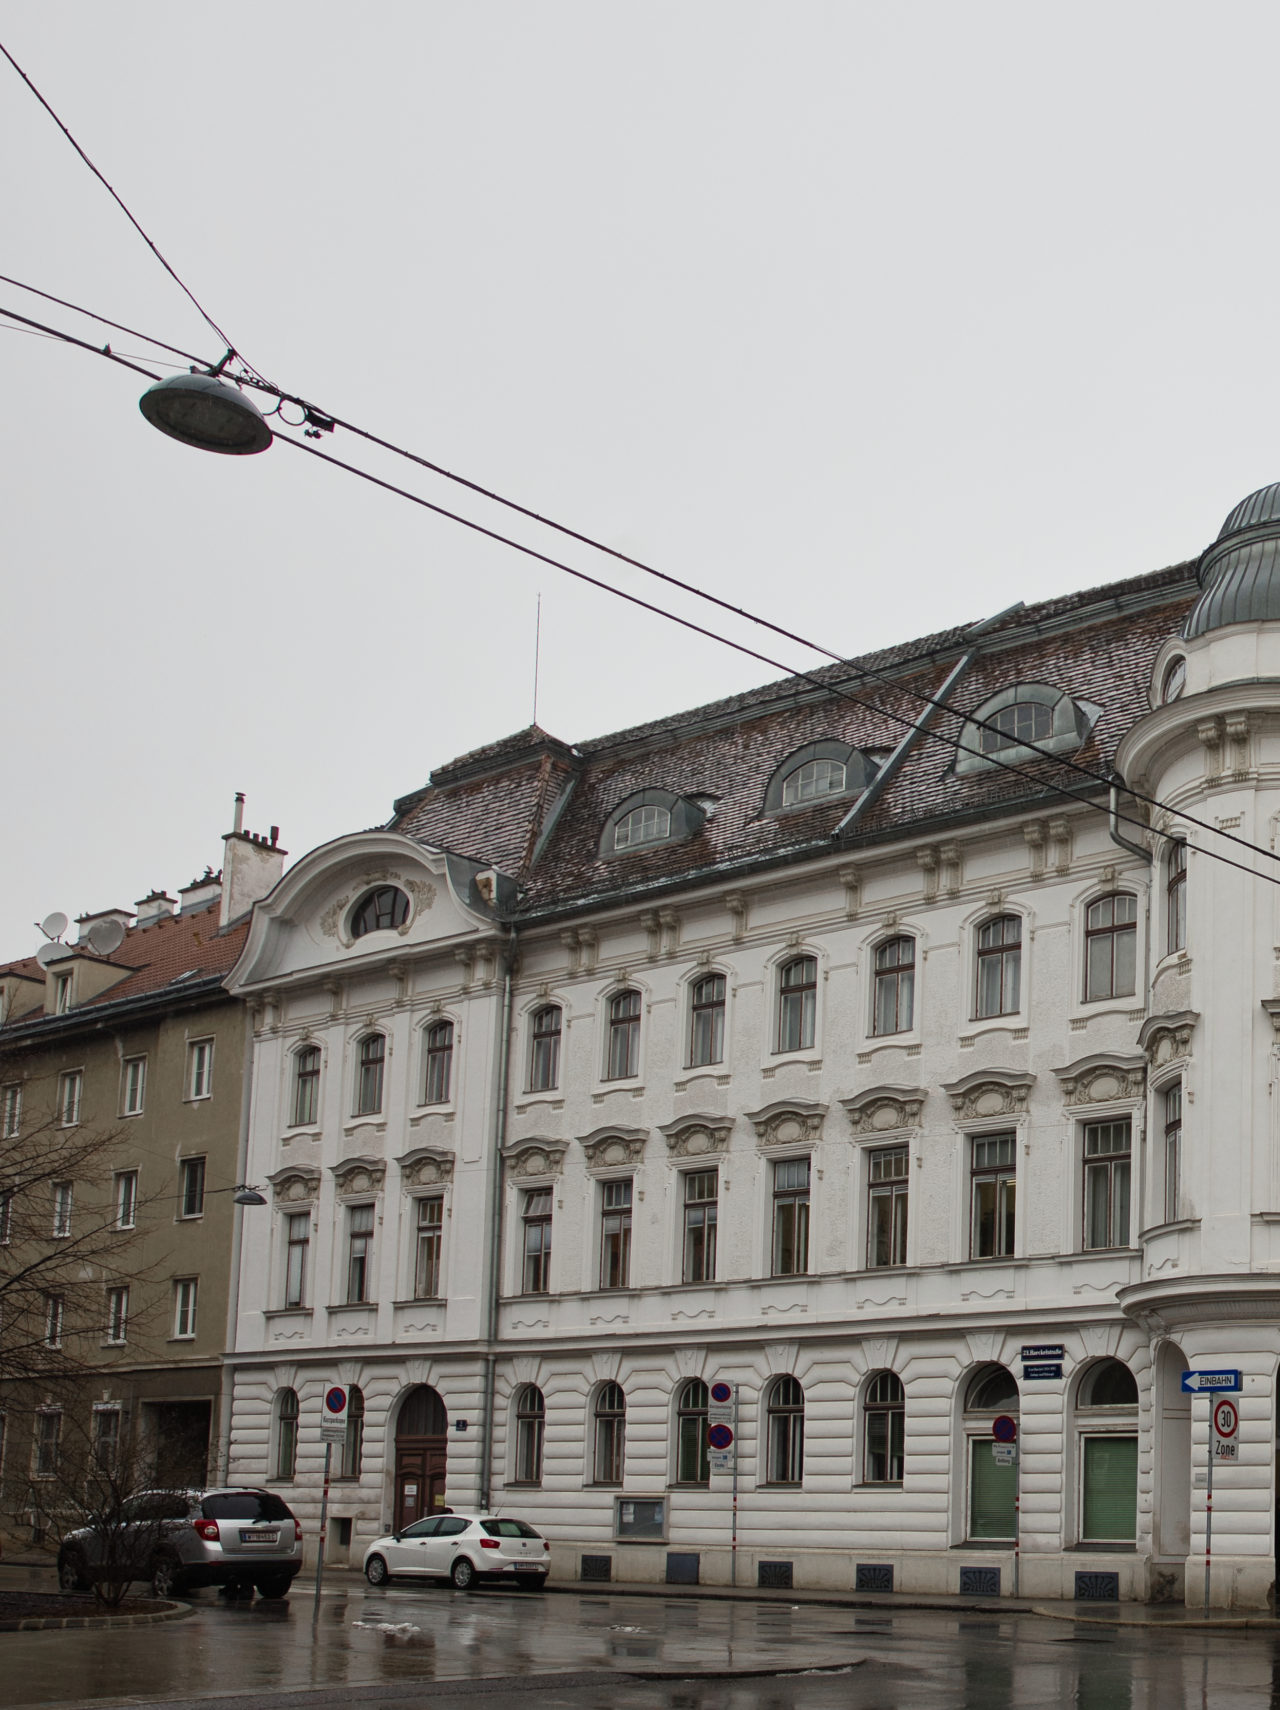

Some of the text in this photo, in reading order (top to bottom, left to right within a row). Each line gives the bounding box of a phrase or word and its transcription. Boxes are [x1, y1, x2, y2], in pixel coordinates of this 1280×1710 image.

[1199, 1375, 1232, 1386] EINBAHN
[1221, 1410, 1232, 1428] 30
[1215, 1440, 1235, 1456] Zone
